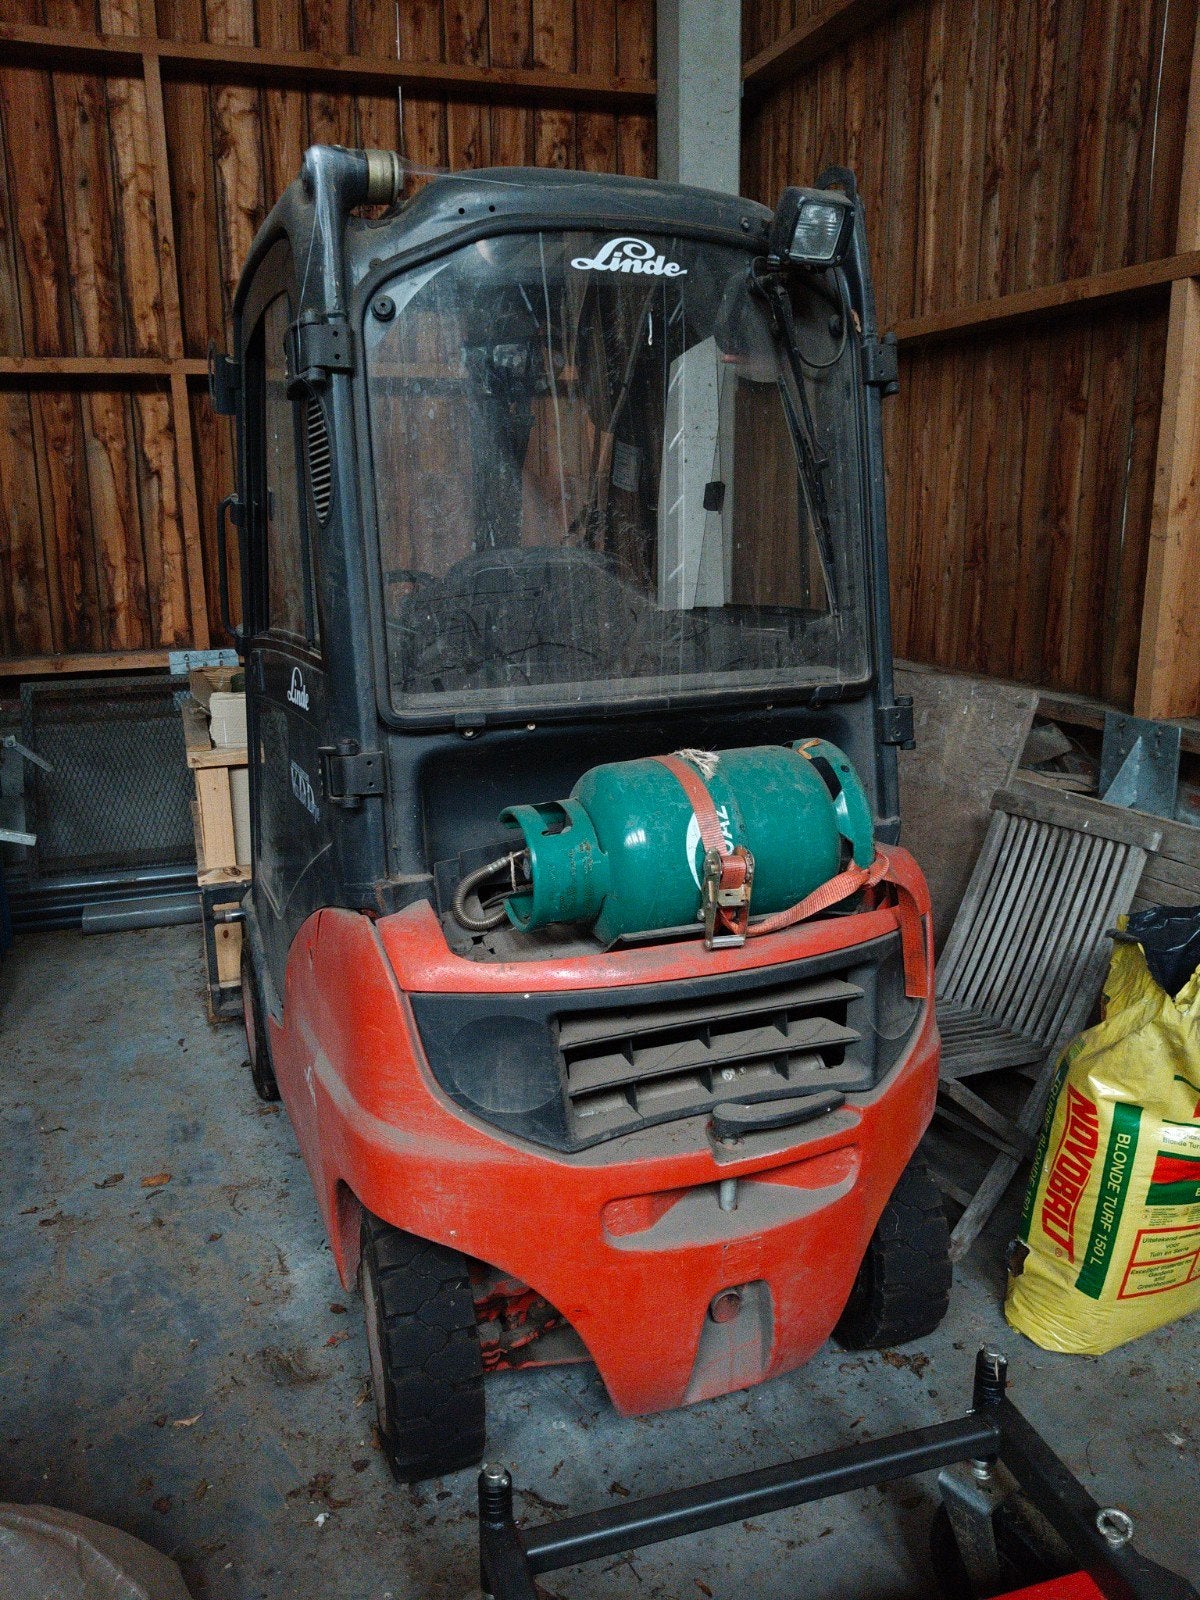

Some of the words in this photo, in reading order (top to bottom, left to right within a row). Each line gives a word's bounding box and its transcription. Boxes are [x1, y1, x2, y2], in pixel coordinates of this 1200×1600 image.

[570, 237, 688, 277] Linde
[287, 667, 310, 712] Linde
[1042, 1083, 1099, 1264] NOVOBALT
[1107, 1133, 1131, 1194] BLONDE
[1099, 1195, 1119, 1233] TURF
[1092, 1233, 1108, 1258] 150
